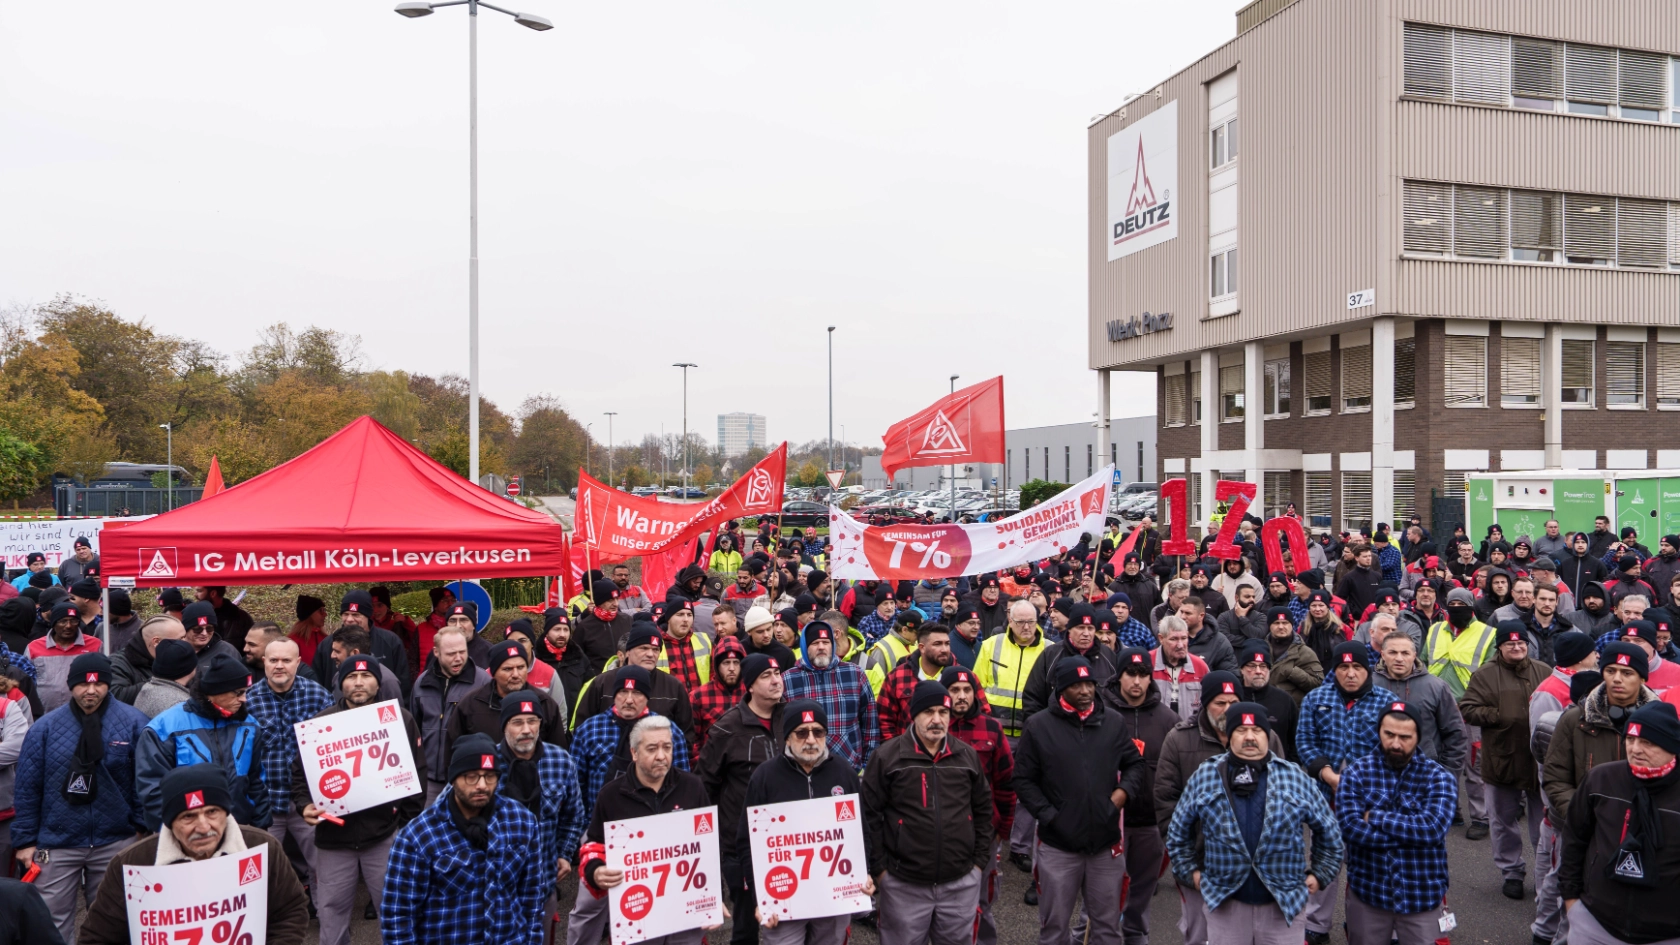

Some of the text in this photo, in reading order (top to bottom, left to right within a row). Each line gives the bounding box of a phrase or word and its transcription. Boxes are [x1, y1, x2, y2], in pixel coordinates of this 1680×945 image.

[1114, 201, 1170, 239] DEUTZ
[1349, 293, 1363, 306] 37
[1107, 311, 1170, 342] Werk Porz
[995, 499, 1077, 534] SOLIDARITÄT
[1023, 509, 1077, 539] GEWINNT
[35, 528, 62, 540] sind
[881, 530, 947, 540] GEMEINSAM FÜR
[1065, 522, 1080, 532] 2024
[4, 542, 61, 552] man uns
[611, 533, 651, 550] unser
[194, 546, 531, 572] IG Metall Köln-Leverkusen
[884, 540, 952, 569] 7%
[316, 728, 390, 756] GEMEINSAM
[318, 754, 343, 769] FÜR
[766, 828, 844, 848] GEMEINSAM
[623, 841, 701, 866] GEMEINSAM
[768, 848, 792, 863] FÜR
[625, 866, 649, 882] FÜR
[772, 873, 789, 881] DAFÜR
[769, 878, 793, 888] STREITEN
[625, 897, 649, 909] STREITEN
[627, 892, 645, 900] DAFÜR
[140, 893, 247, 927] GEMEINSAM
[141, 928, 169, 945] FÜR
